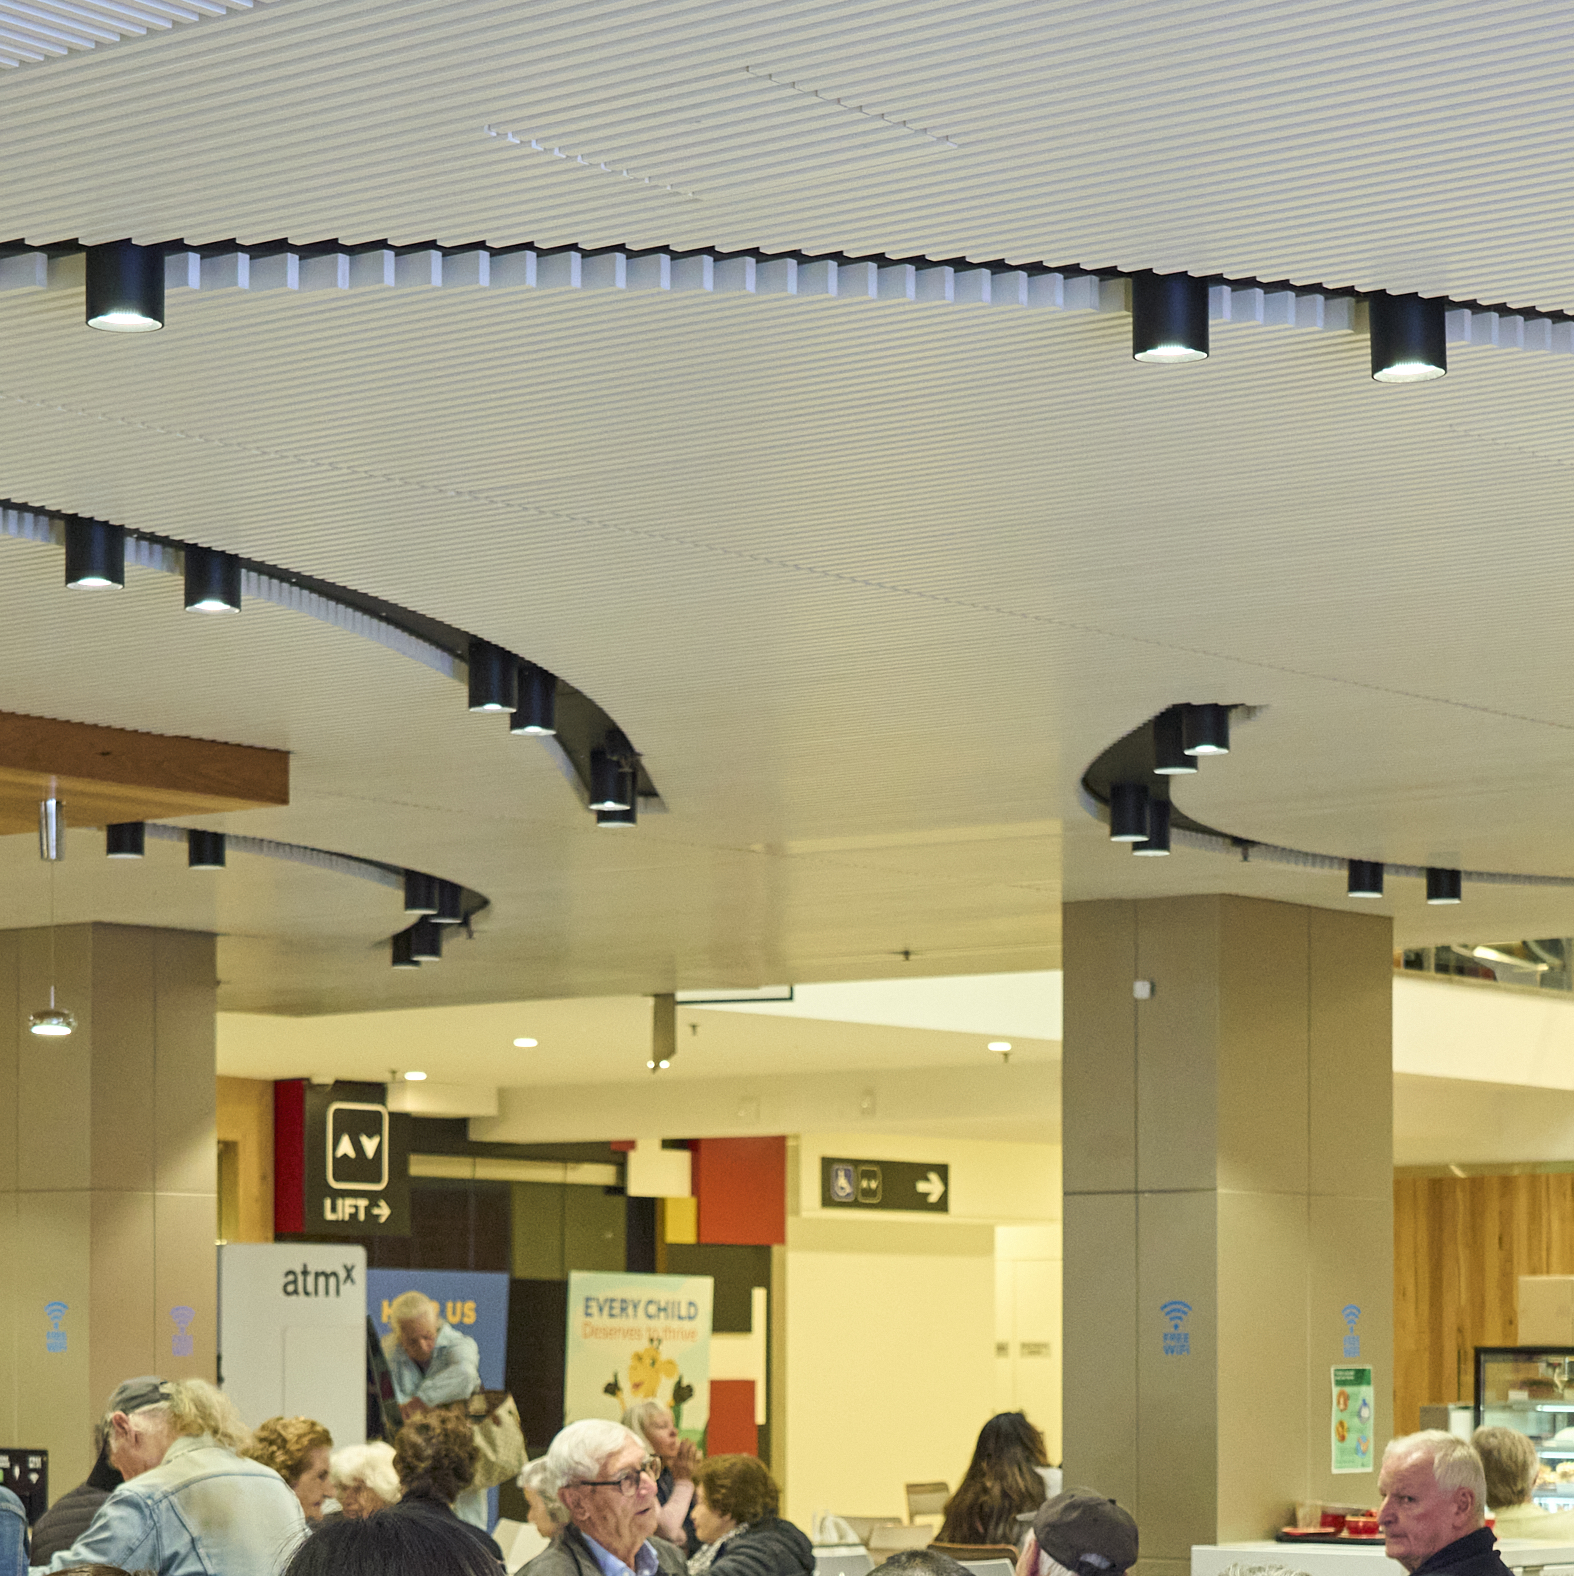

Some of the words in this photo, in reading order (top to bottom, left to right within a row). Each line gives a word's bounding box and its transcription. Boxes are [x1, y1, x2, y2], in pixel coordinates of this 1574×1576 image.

[323, 1197, 369, 1221] LIFT
[446, 1299, 477, 1325] US
[583, 1297, 642, 1319] EVERY
[644, 1299, 698, 1321] CHILD
[581, 1321, 642, 1340] Deserves
